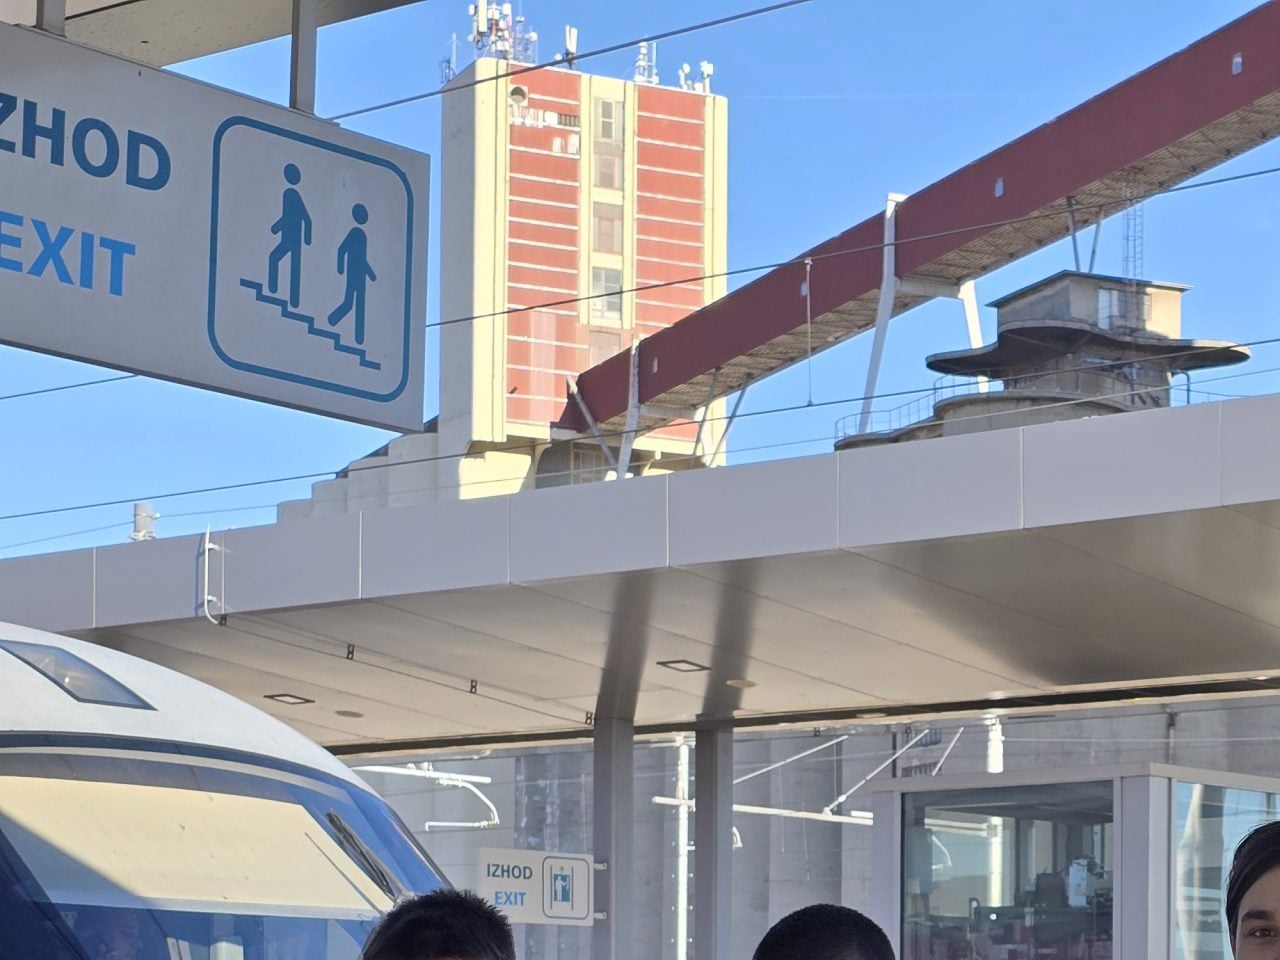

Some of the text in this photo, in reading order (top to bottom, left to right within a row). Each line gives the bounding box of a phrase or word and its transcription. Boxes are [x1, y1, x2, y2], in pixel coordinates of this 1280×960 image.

[0, 210, 136, 297] EXIT
[487, 863, 533, 880] IZHOD
[494, 891, 526, 906] EXIT
